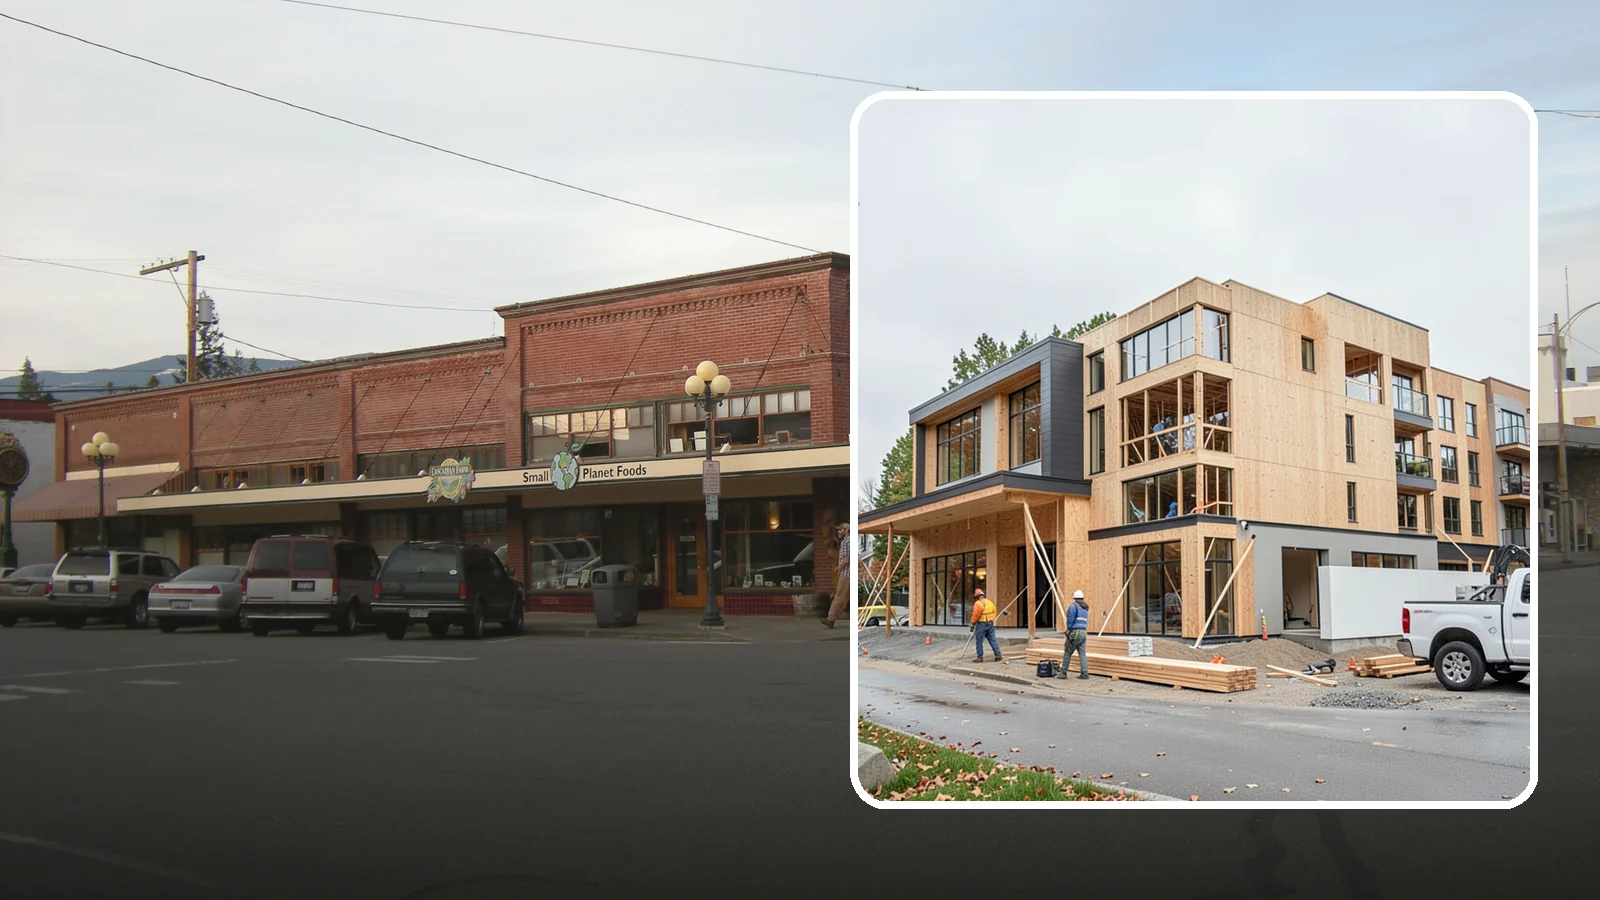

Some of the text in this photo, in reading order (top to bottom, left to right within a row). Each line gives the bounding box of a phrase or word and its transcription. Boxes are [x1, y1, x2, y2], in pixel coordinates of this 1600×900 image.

[523, 464, 647, 482] Small Planet Foods
